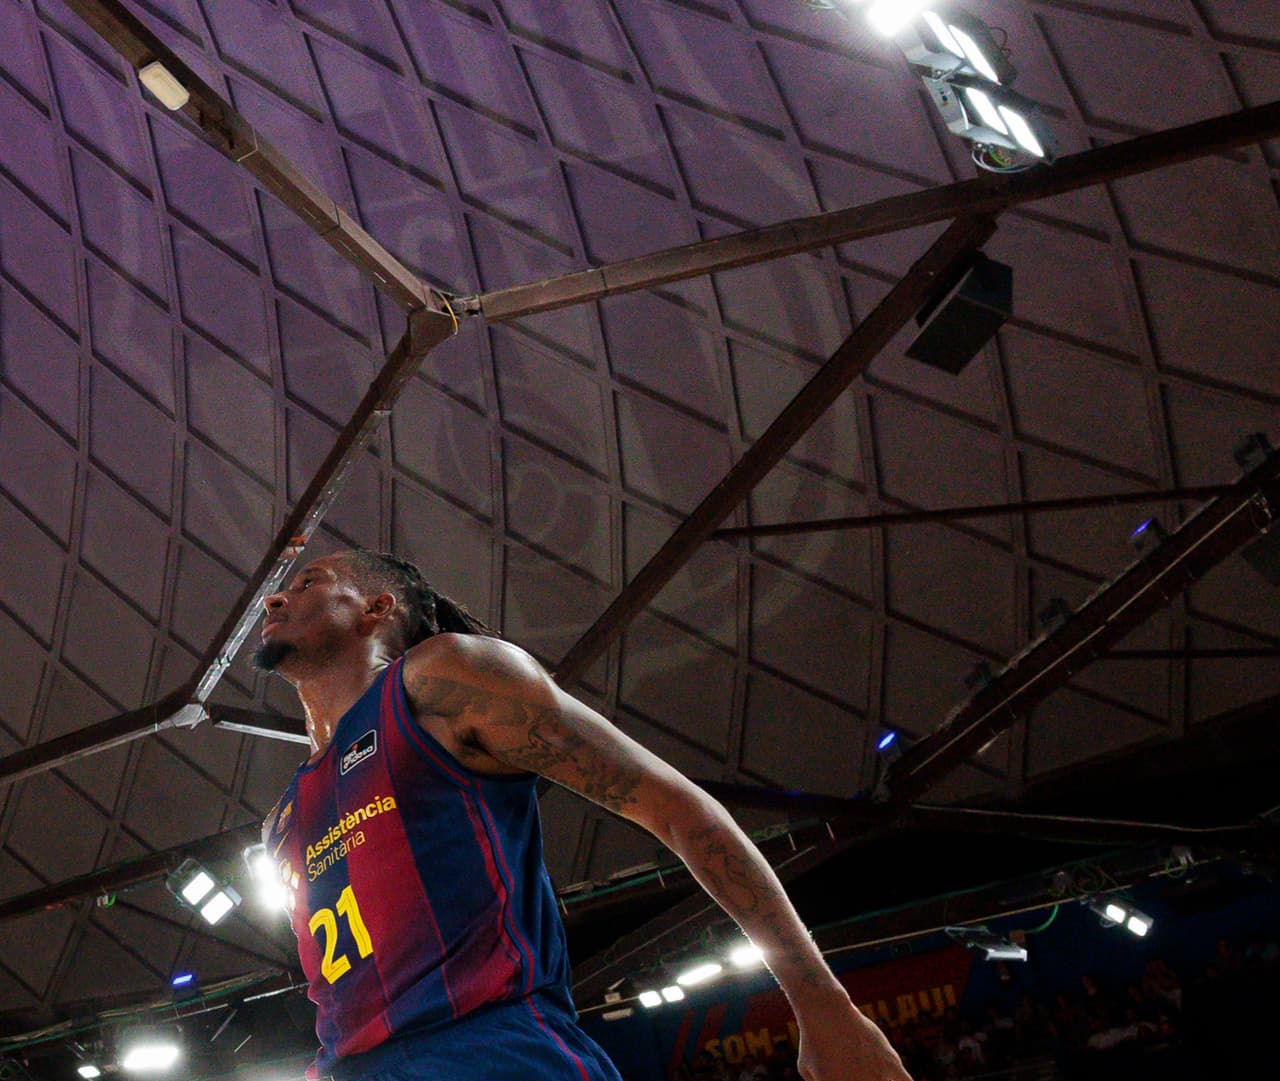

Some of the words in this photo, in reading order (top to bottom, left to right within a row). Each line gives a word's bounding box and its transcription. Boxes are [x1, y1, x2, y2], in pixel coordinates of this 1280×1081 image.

[304, 795, 398, 865] Assistència
[307, 829, 367, 883] Sanitària
[308, 884, 375, 985] 21
